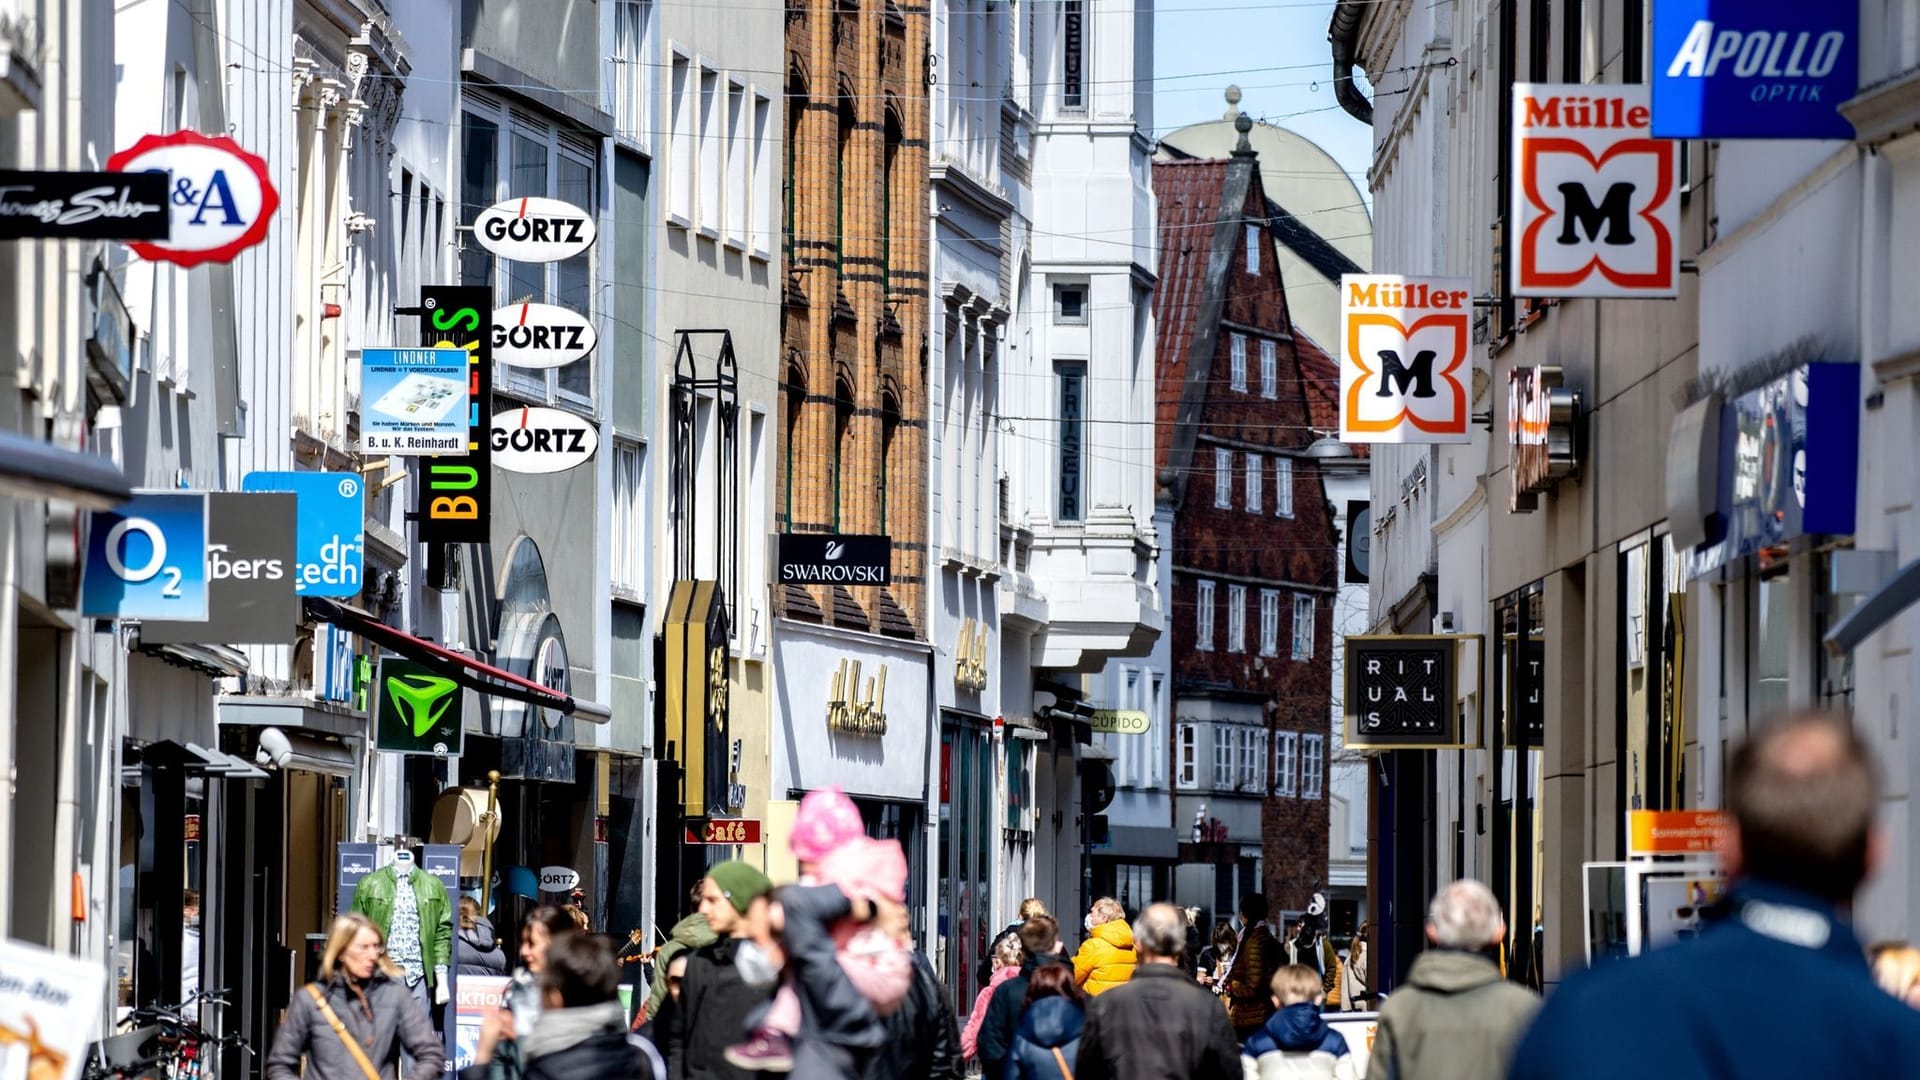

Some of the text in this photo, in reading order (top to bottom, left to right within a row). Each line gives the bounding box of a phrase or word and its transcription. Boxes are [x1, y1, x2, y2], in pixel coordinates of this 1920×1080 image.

[1666, 20, 1845, 78] APOLLO
[1751, 84, 1824, 102] OPTIK
[1523, 96, 1650, 129] Mülle
[56, 186, 161, 226] Sabo
[142, 168, 246, 227] &A
[1556, 182, 1637, 246] M
[1348, 283, 1468, 310] Müller
[393, 351, 436, 365] LINDNER
[1375, 349, 1437, 398] M
[368, 437, 459, 449] B. u. K. Reinhardt
[1061, 377, 1078, 517] FRISEUR
[783, 564, 885, 582] SWAROVSKI
[702, 822, 746, 841] Café
[343, 866, 371, 875] engbers
[427, 868, 456, 876] engbers
